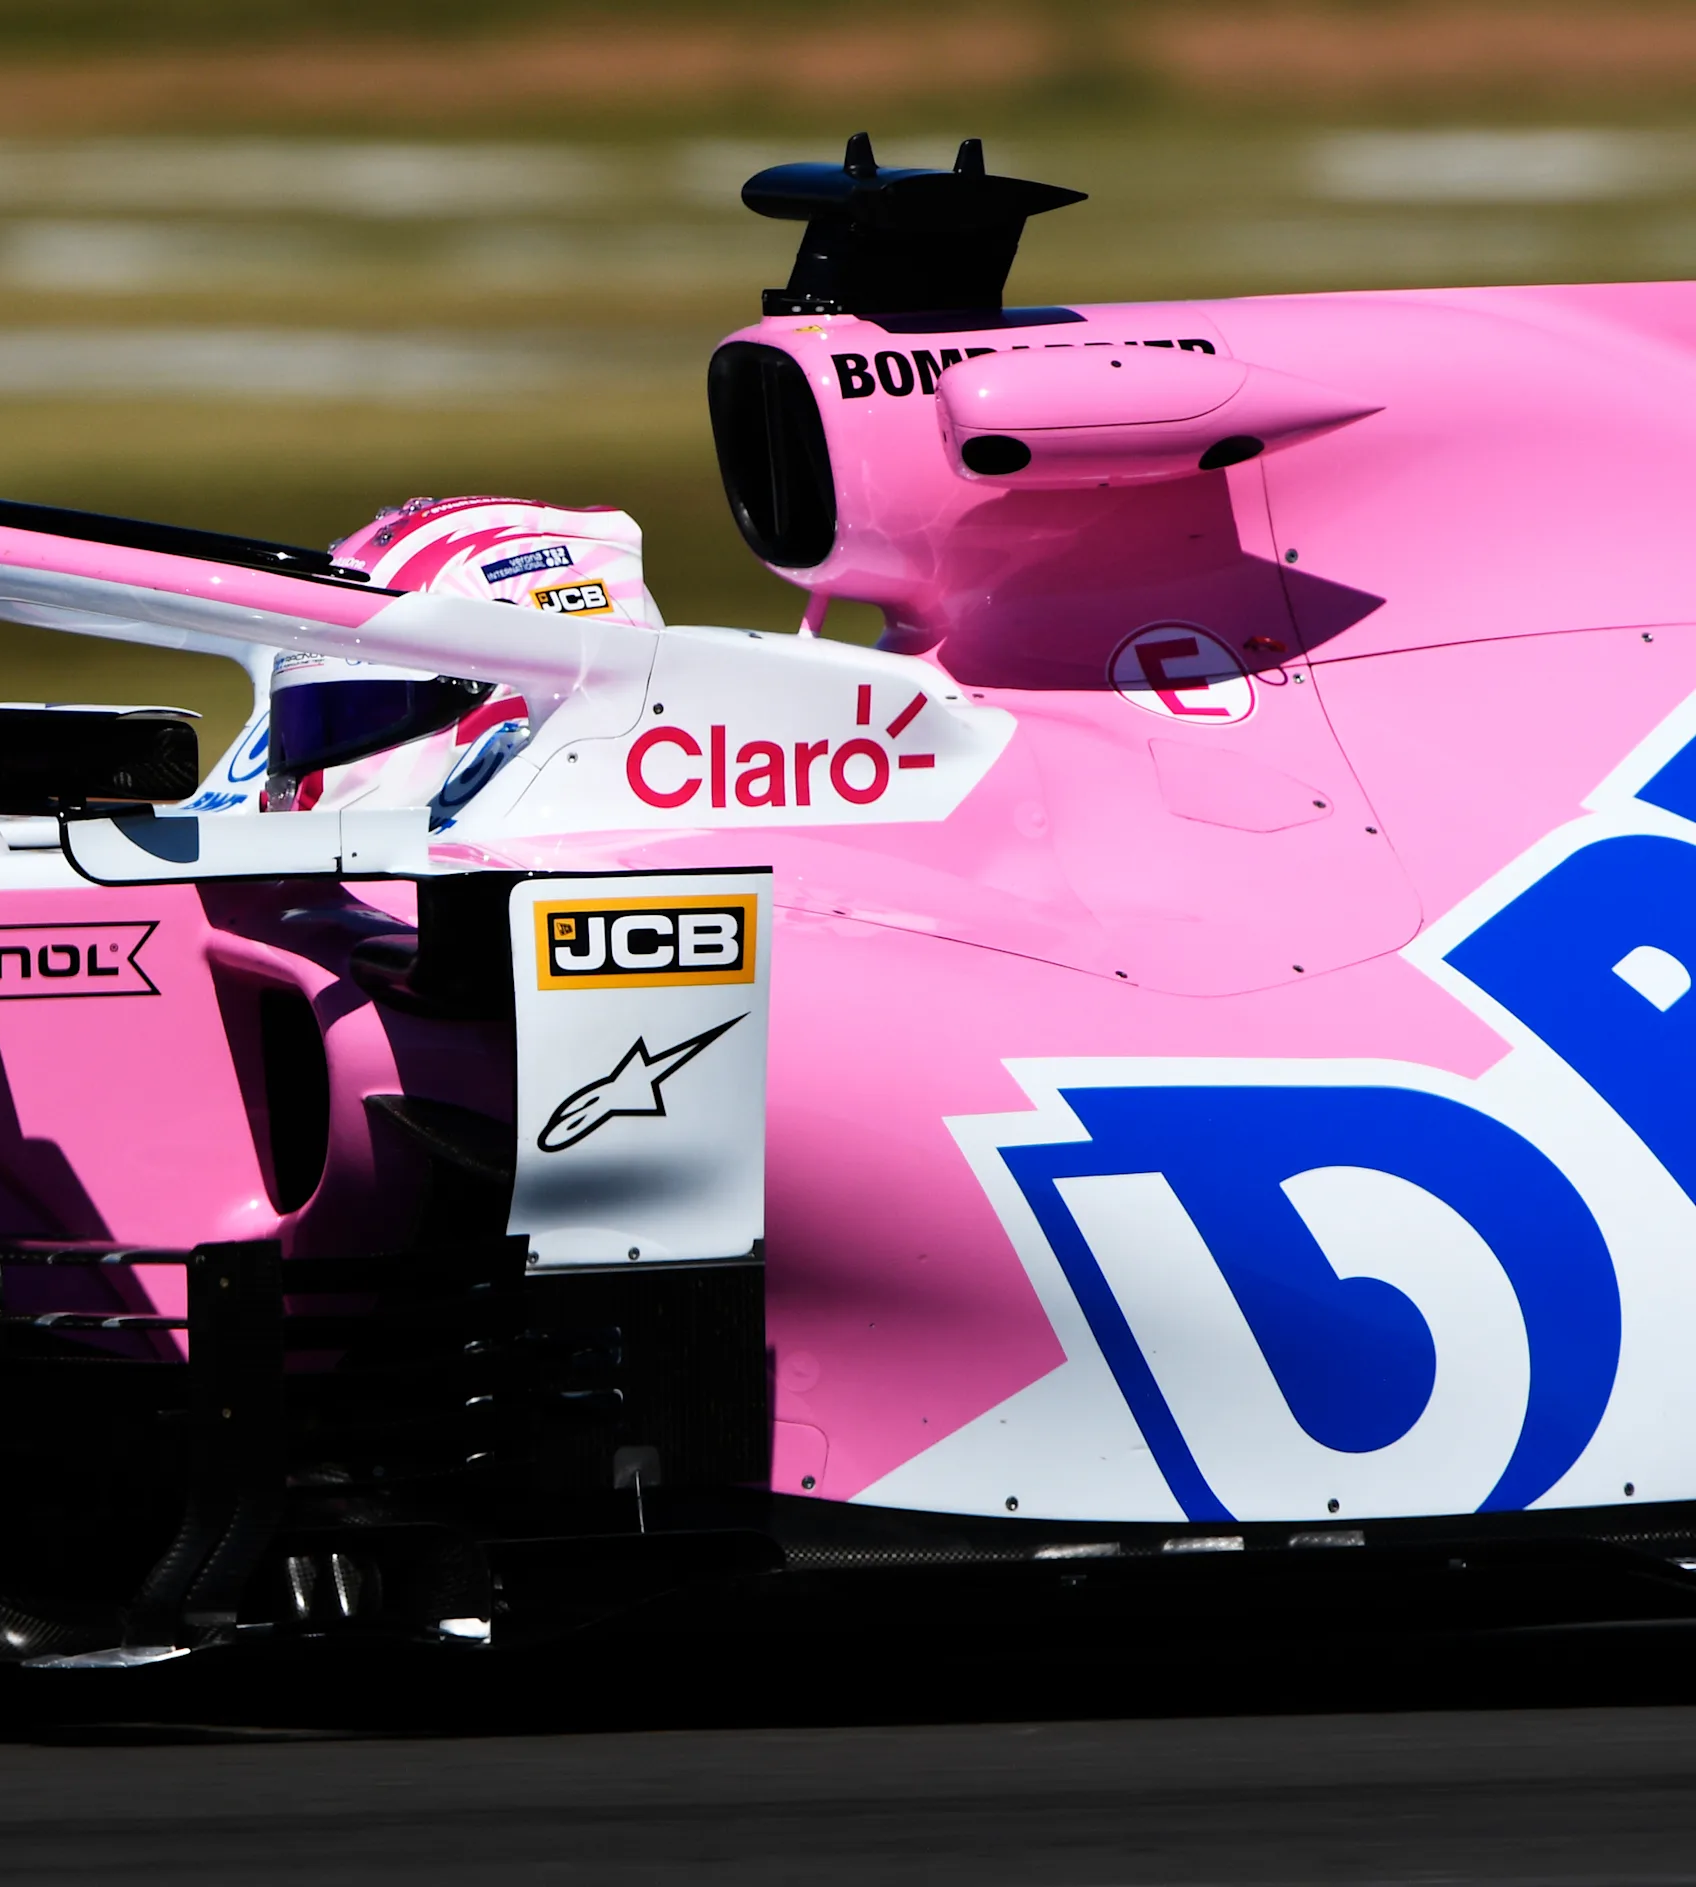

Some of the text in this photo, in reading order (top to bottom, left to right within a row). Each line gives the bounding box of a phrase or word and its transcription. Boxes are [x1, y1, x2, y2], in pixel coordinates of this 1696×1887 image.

[542, 584, 606, 613] JCB
[1134, 636, 1232, 718] E
[625, 723, 891, 809] Claro
[180, 791, 249, 813] BWT
[554, 913, 739, 971] JCB
